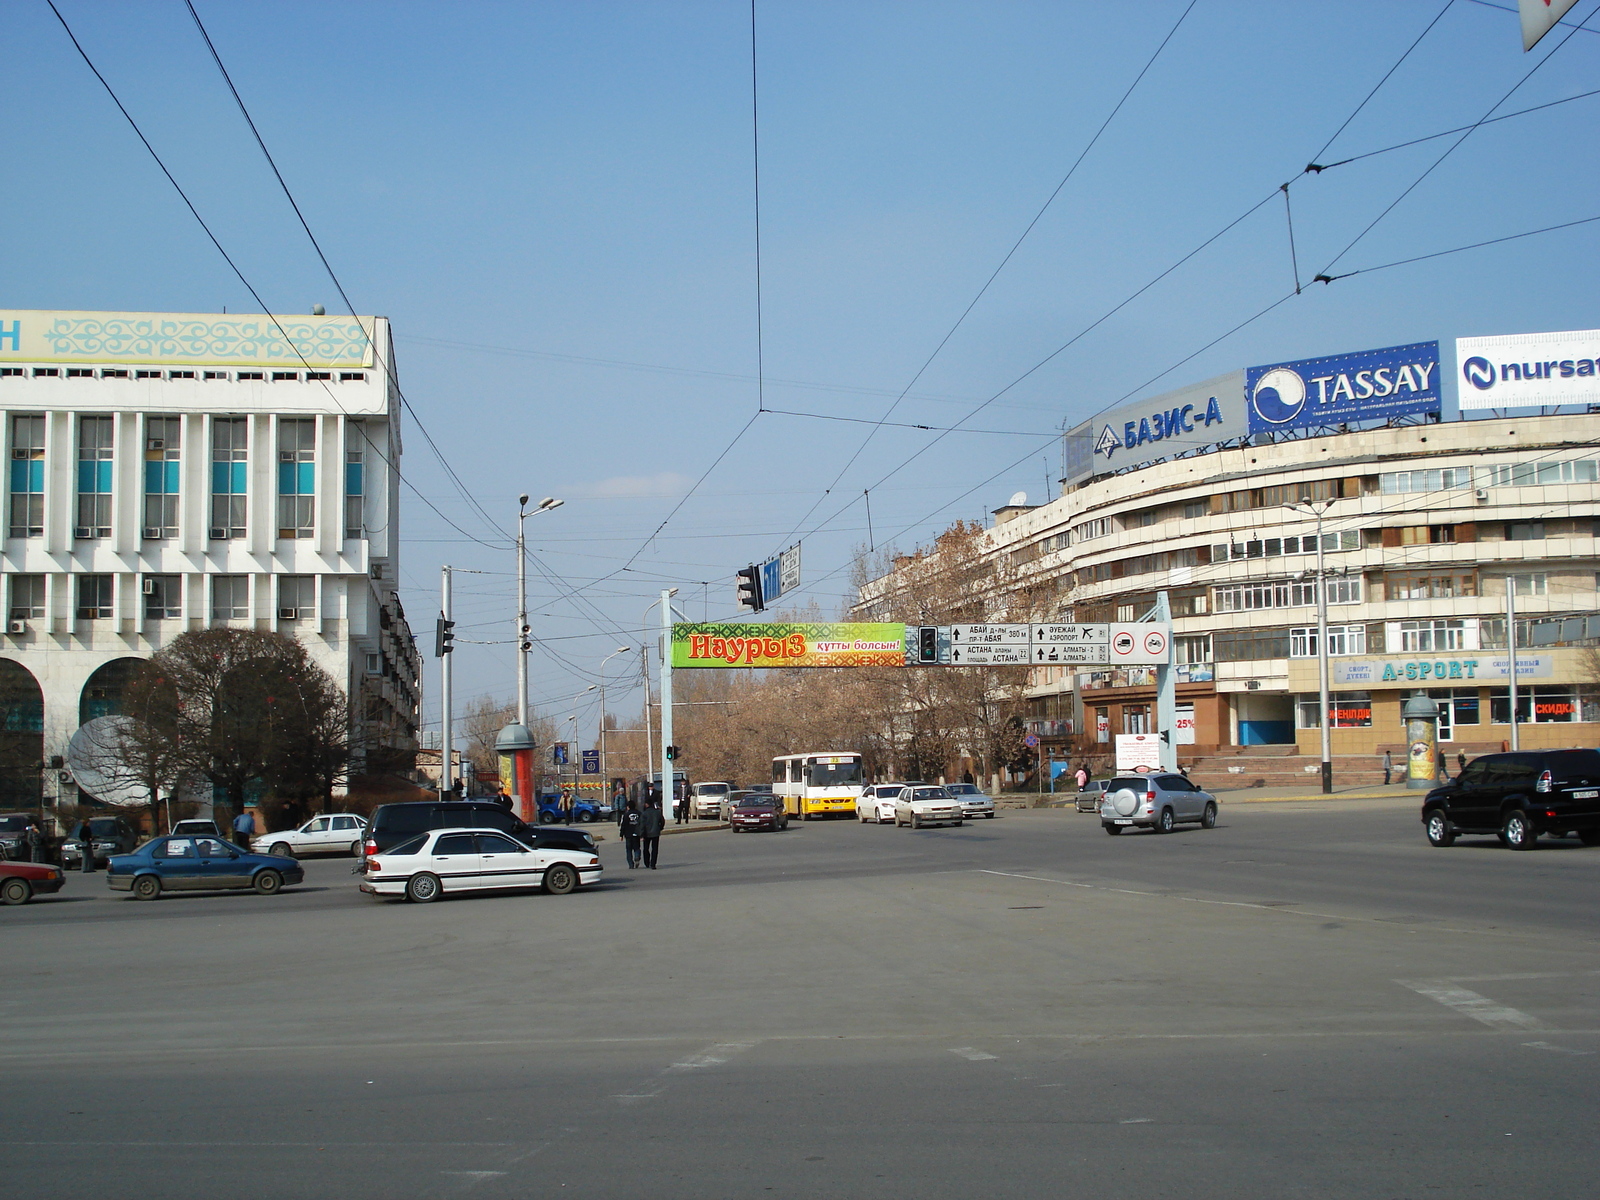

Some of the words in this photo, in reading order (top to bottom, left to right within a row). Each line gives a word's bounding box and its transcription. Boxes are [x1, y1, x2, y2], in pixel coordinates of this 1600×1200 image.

[1310, 361, 1436, 404] TASSAY
[1124, 396, 1224, 450] БАЗИС-А
[970, 625, 987, 634] АБАЙ
[1049, 625, 1076, 633] ӘУЕЖАЙ
[984, 634, 1002, 642] АБАЯ
[688, 633, 807, 664] Наурыз
[817, 642, 850, 653] құтты
[854, 639, 900, 652] болсын!
[992, 654, 1019, 662] АСТАНА
[1382, 660, 1479, 682] A-SPORT
[1500, 667, 1535, 675] МААЗИН
[1536, 703, 1577, 715] СКИДКА
